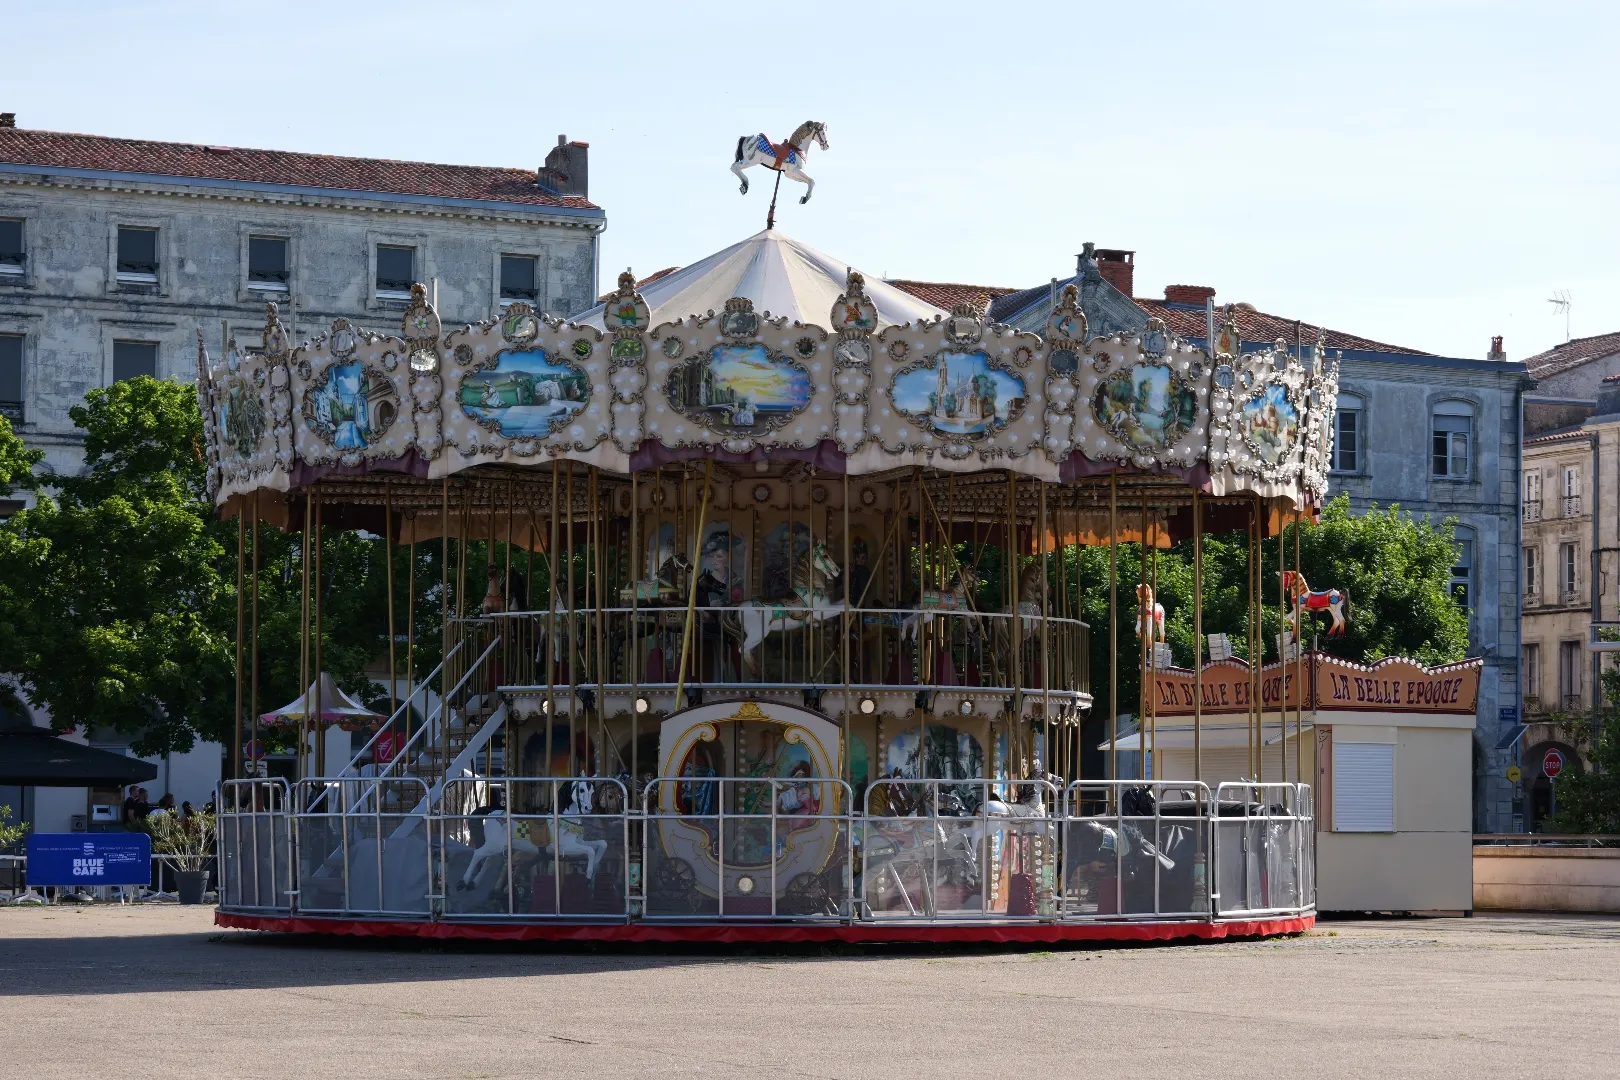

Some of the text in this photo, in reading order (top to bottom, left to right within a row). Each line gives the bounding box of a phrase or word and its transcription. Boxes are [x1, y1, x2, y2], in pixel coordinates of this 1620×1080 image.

[1156, 680, 1179, 705] LA
[1330, 672, 1463, 707] LA BELLE EPOQUE
[1545, 761, 1560, 769] STOP
[73, 858, 104, 866] BLUE
